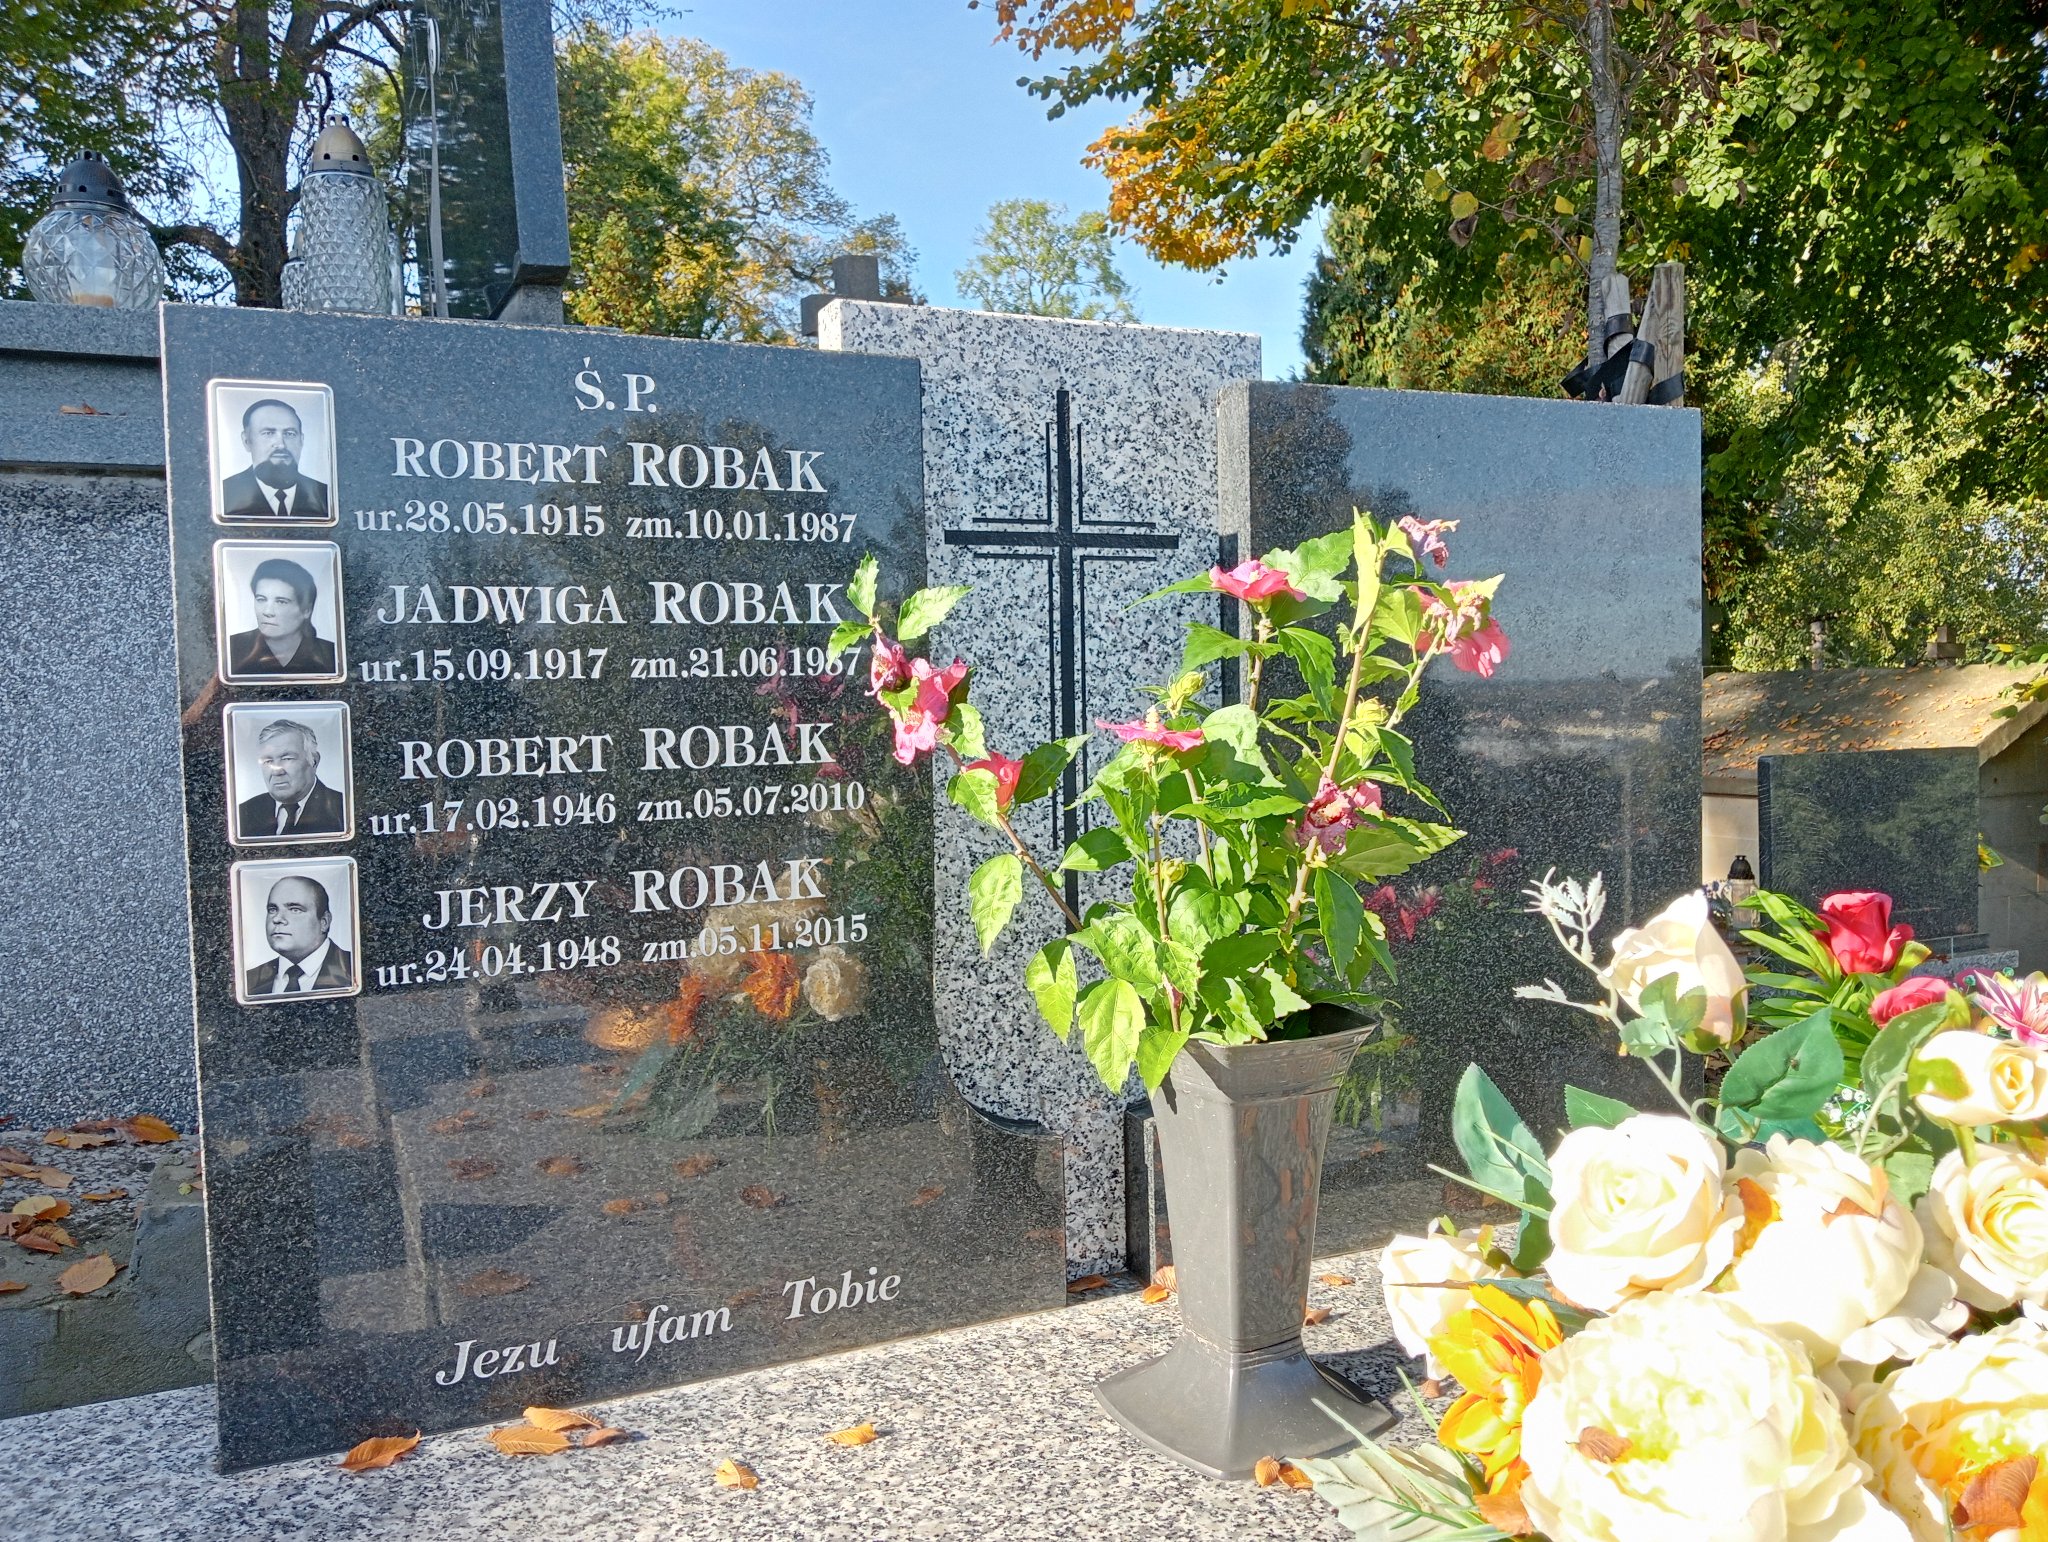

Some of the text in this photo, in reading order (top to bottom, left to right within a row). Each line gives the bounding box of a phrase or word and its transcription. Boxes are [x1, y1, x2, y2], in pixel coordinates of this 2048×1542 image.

[574, 357, 658, 413] Ś.P.
[390, 437, 828, 494] ROBERT ROBAK
[354, 499, 858, 544] ur.28.05.1915 zm.10.01.1987
[377, 581, 844, 626] JADWIGA ROBAK
[358, 647, 609, 683] ur.15.09.1917
[399, 722, 837, 780] ROBERT ROBAK
[369, 780, 866, 836] ur.17.02.1946 zm.05.07.2010
[422, 858, 826, 931] JERZY ROBAK
[376, 913, 869, 988] ur.24.04.1948 zm.05.11.2015
[435, 1266, 901, 1386] Jezu ufam Tobie
